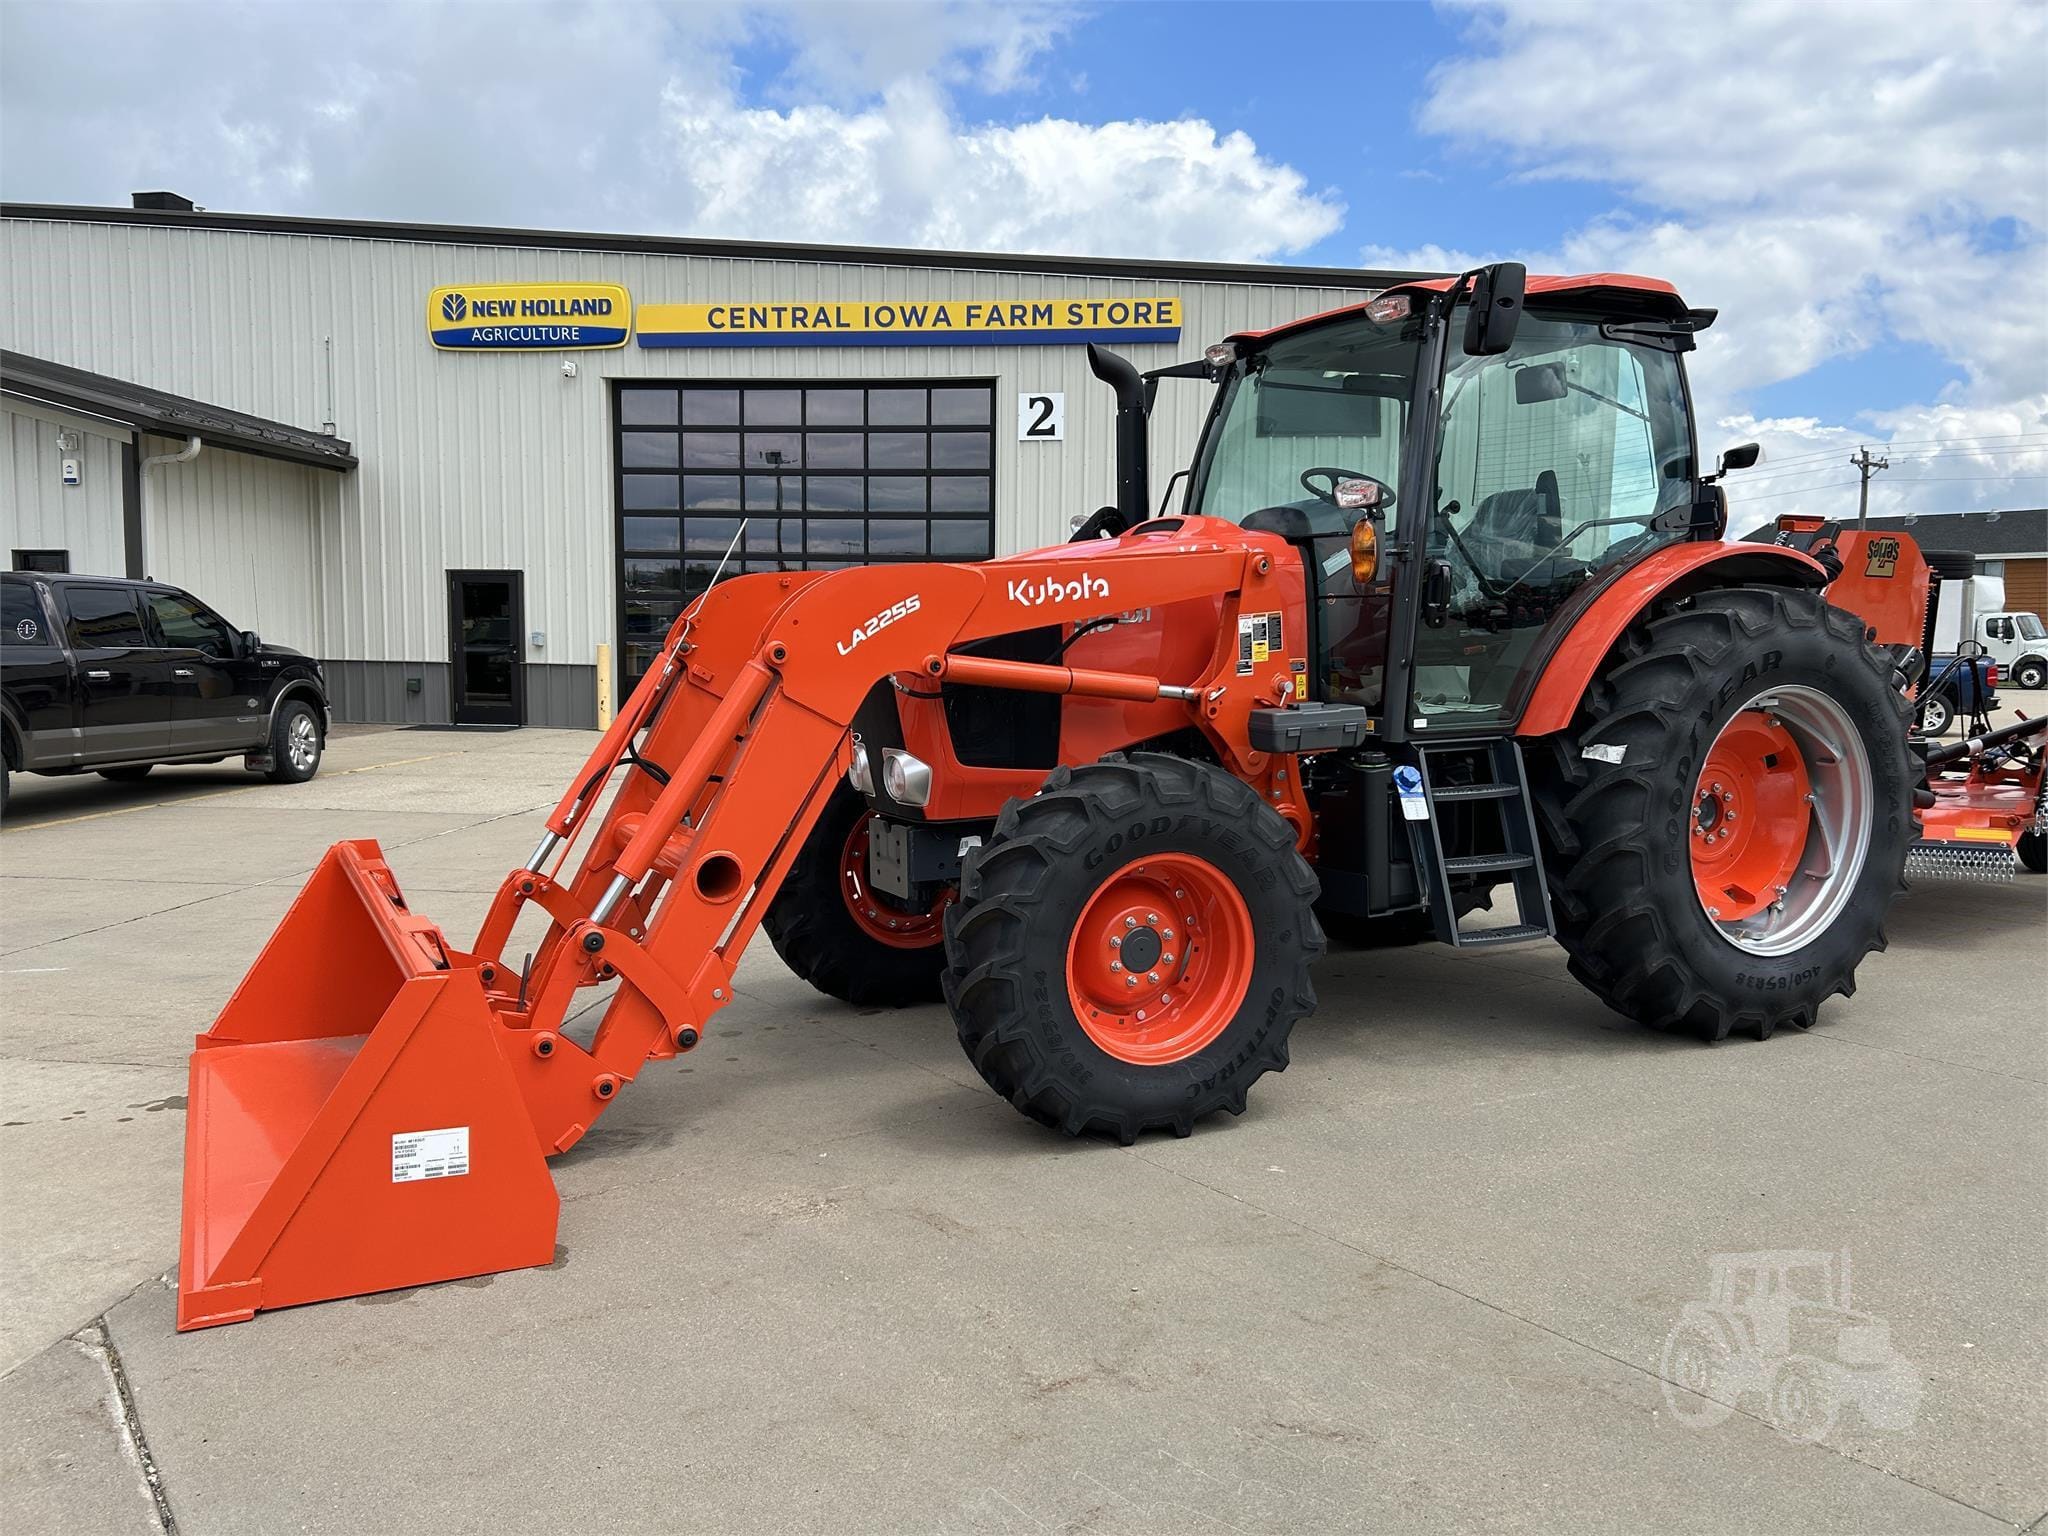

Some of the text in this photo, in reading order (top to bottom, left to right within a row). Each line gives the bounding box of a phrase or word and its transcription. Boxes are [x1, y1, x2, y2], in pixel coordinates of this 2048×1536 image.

[472, 298, 612, 317] NEW HOLLAND
[707, 301, 1173, 329] CENTRAL IOWA FARM STORE
[471, 327, 580, 342] AGRICULTURE
[1026, 397, 1056, 436] 2
[1867, 540, 1900, 561] series
[1008, 572, 1110, 607] Kubota
[836, 594, 921, 656] LA2255
[1735, 964, 1822, 991] 460/85R38
